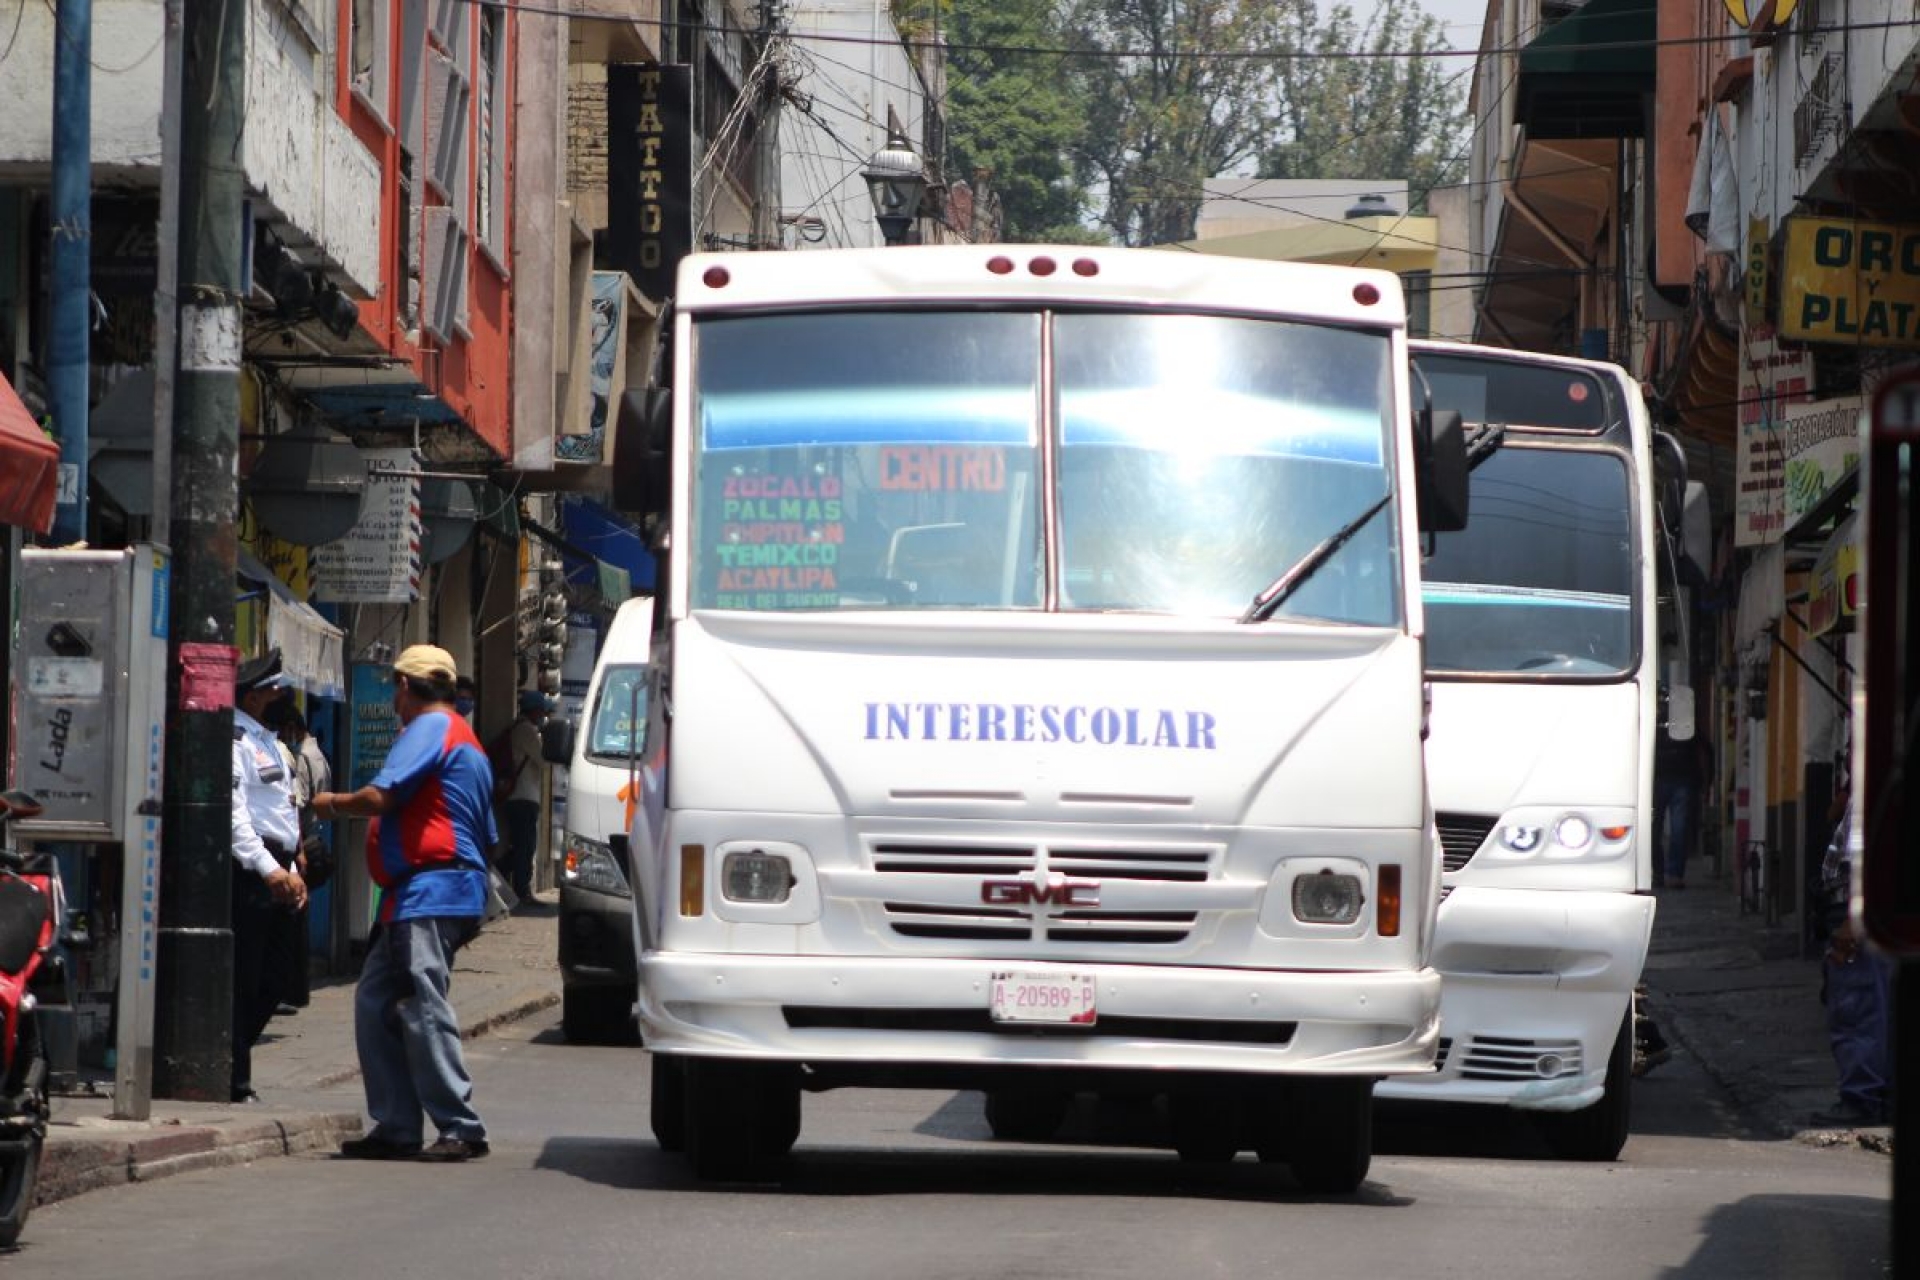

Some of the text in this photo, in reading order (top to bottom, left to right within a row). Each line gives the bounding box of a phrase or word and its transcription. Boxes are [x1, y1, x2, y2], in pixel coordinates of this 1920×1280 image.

[637, 72, 663, 268] TATTOO
[1867, 279, 1881, 295] Y
[1802, 293, 1920, 337] PLAT
[879, 446, 1006, 491] CENTRO
[723, 476, 842, 498] ZOCALO
[723, 499, 841, 521] PALMAS
[716, 544, 837, 566] TEMIXCO
[718, 567, 838, 590] ACATLIPA
[863, 701, 1217, 750] INTERESCOLAR
[40, 706, 73, 774] Lada
[981, 880, 1101, 907] GMC
[994, 985, 1092, 1008] A-20589-P
